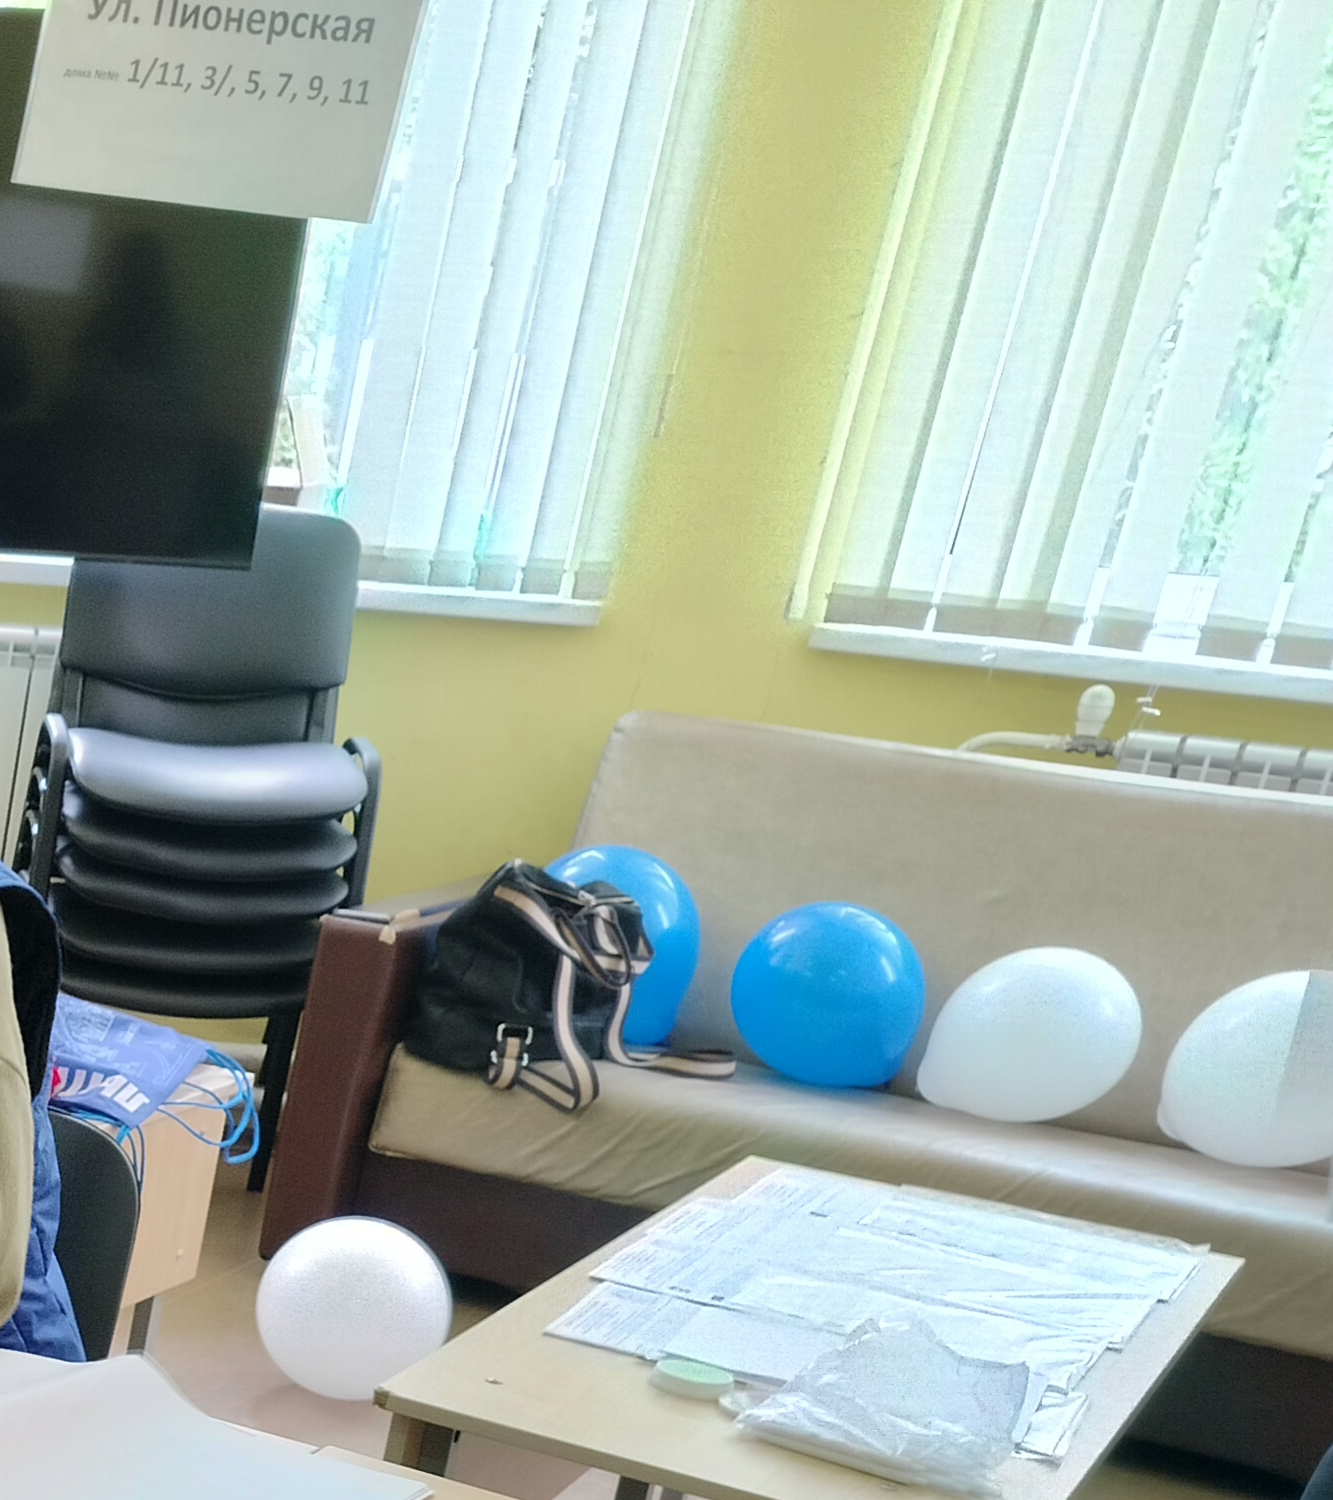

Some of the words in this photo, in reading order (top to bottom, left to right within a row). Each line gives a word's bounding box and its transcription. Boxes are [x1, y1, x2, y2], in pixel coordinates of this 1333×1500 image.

[153, 0, 376, 45] Пионерская
[63, 67, 92, 79] дома
[127, 57, 192, 93] 1/11,
[200, 64, 236, 98] 3/,
[244, 70, 267, 100] 5,
[276, 72, 298, 104] 7,
[306, 75, 329, 107] 9,
[338, 78, 370, 106] 11
